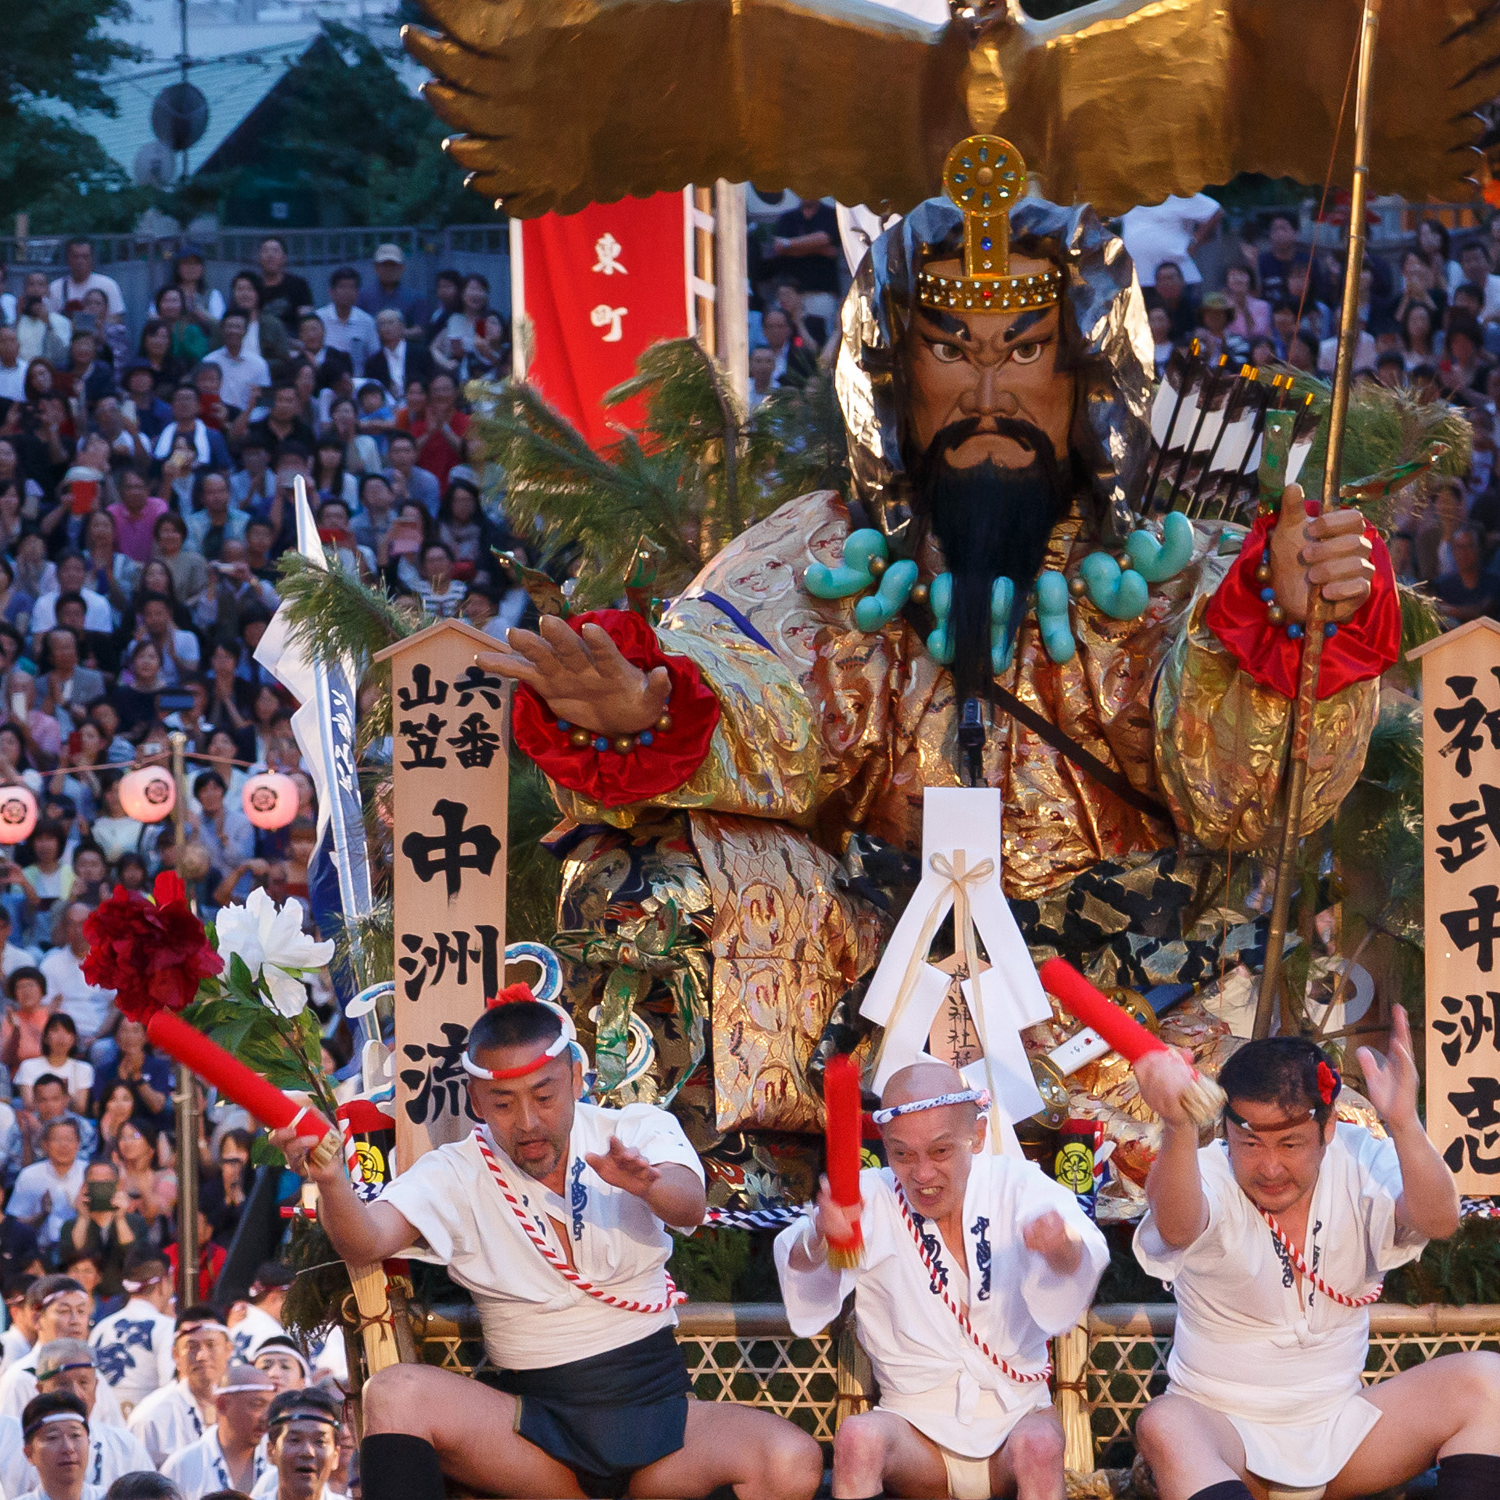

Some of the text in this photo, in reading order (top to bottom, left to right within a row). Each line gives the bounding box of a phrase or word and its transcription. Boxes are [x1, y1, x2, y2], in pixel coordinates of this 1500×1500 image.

[591, 233, 629, 342] 東町
[398, 664, 449, 770] 山笠
[447, 664, 501, 770] 六番
[400, 798, 502, 1126] 中洲流
